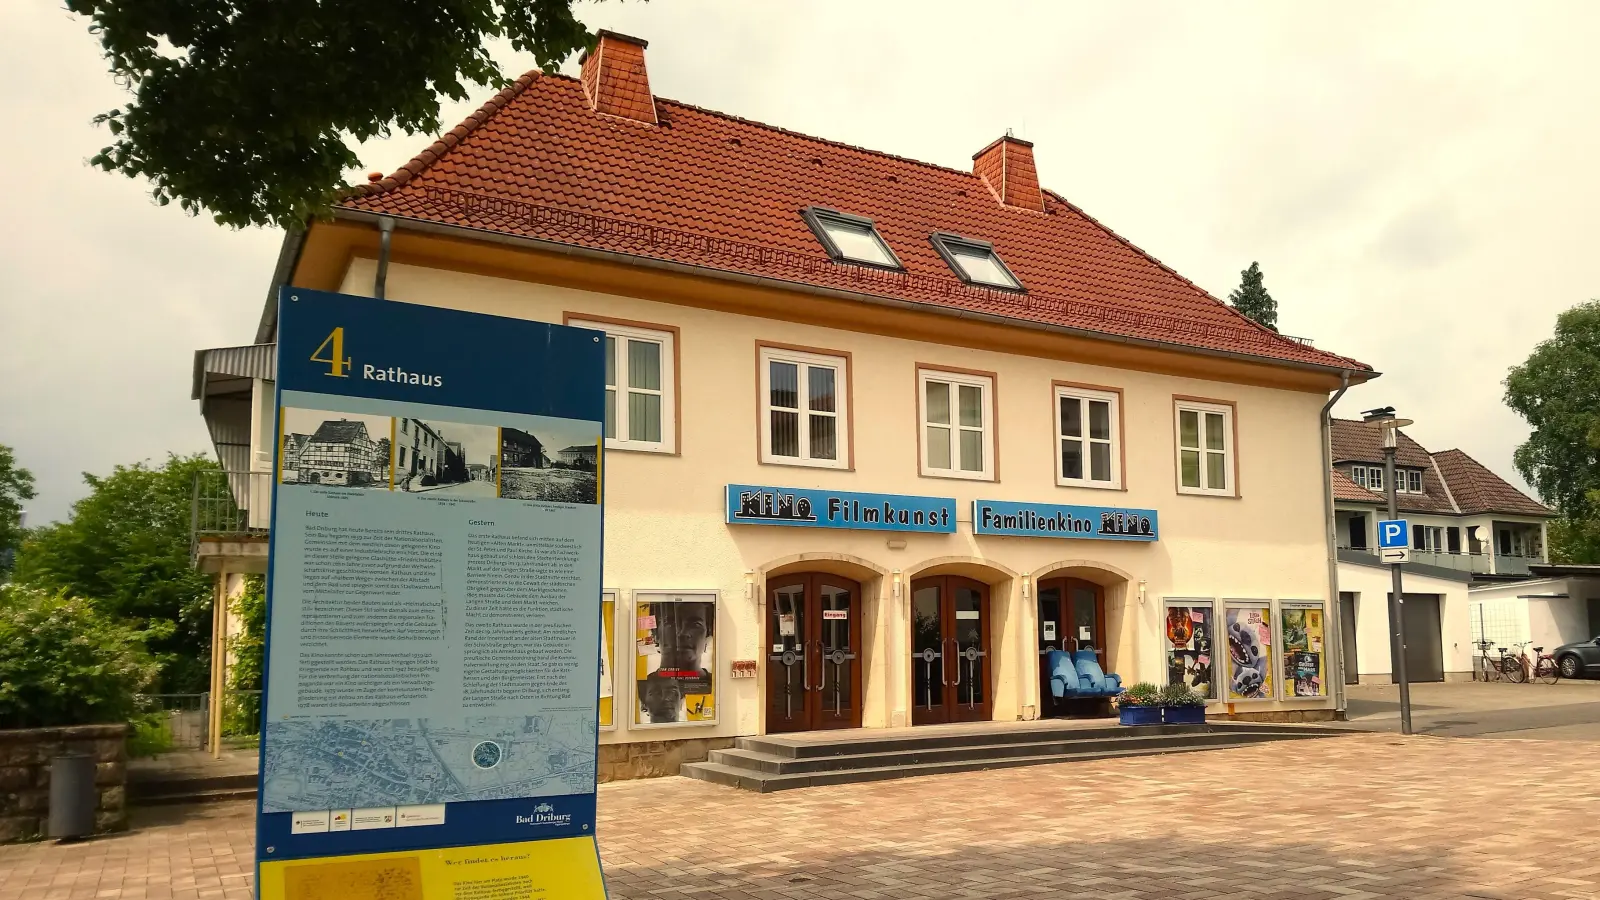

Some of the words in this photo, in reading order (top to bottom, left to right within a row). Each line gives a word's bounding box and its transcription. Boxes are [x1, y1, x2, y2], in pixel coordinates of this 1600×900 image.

[310, 327, 351, 378] 4
[363, 364, 443, 387] Rathaus
[737, 489, 816, 521] KINO
[827, 498, 949, 527] Filmkunst
[982, 506, 1092, 533] Familienkino
[1098, 510, 1154, 535] KINO
[1386, 524, 1400, 544] P
[516, 814, 533, 823] Bad
[536, 813, 571, 822] Driburg
